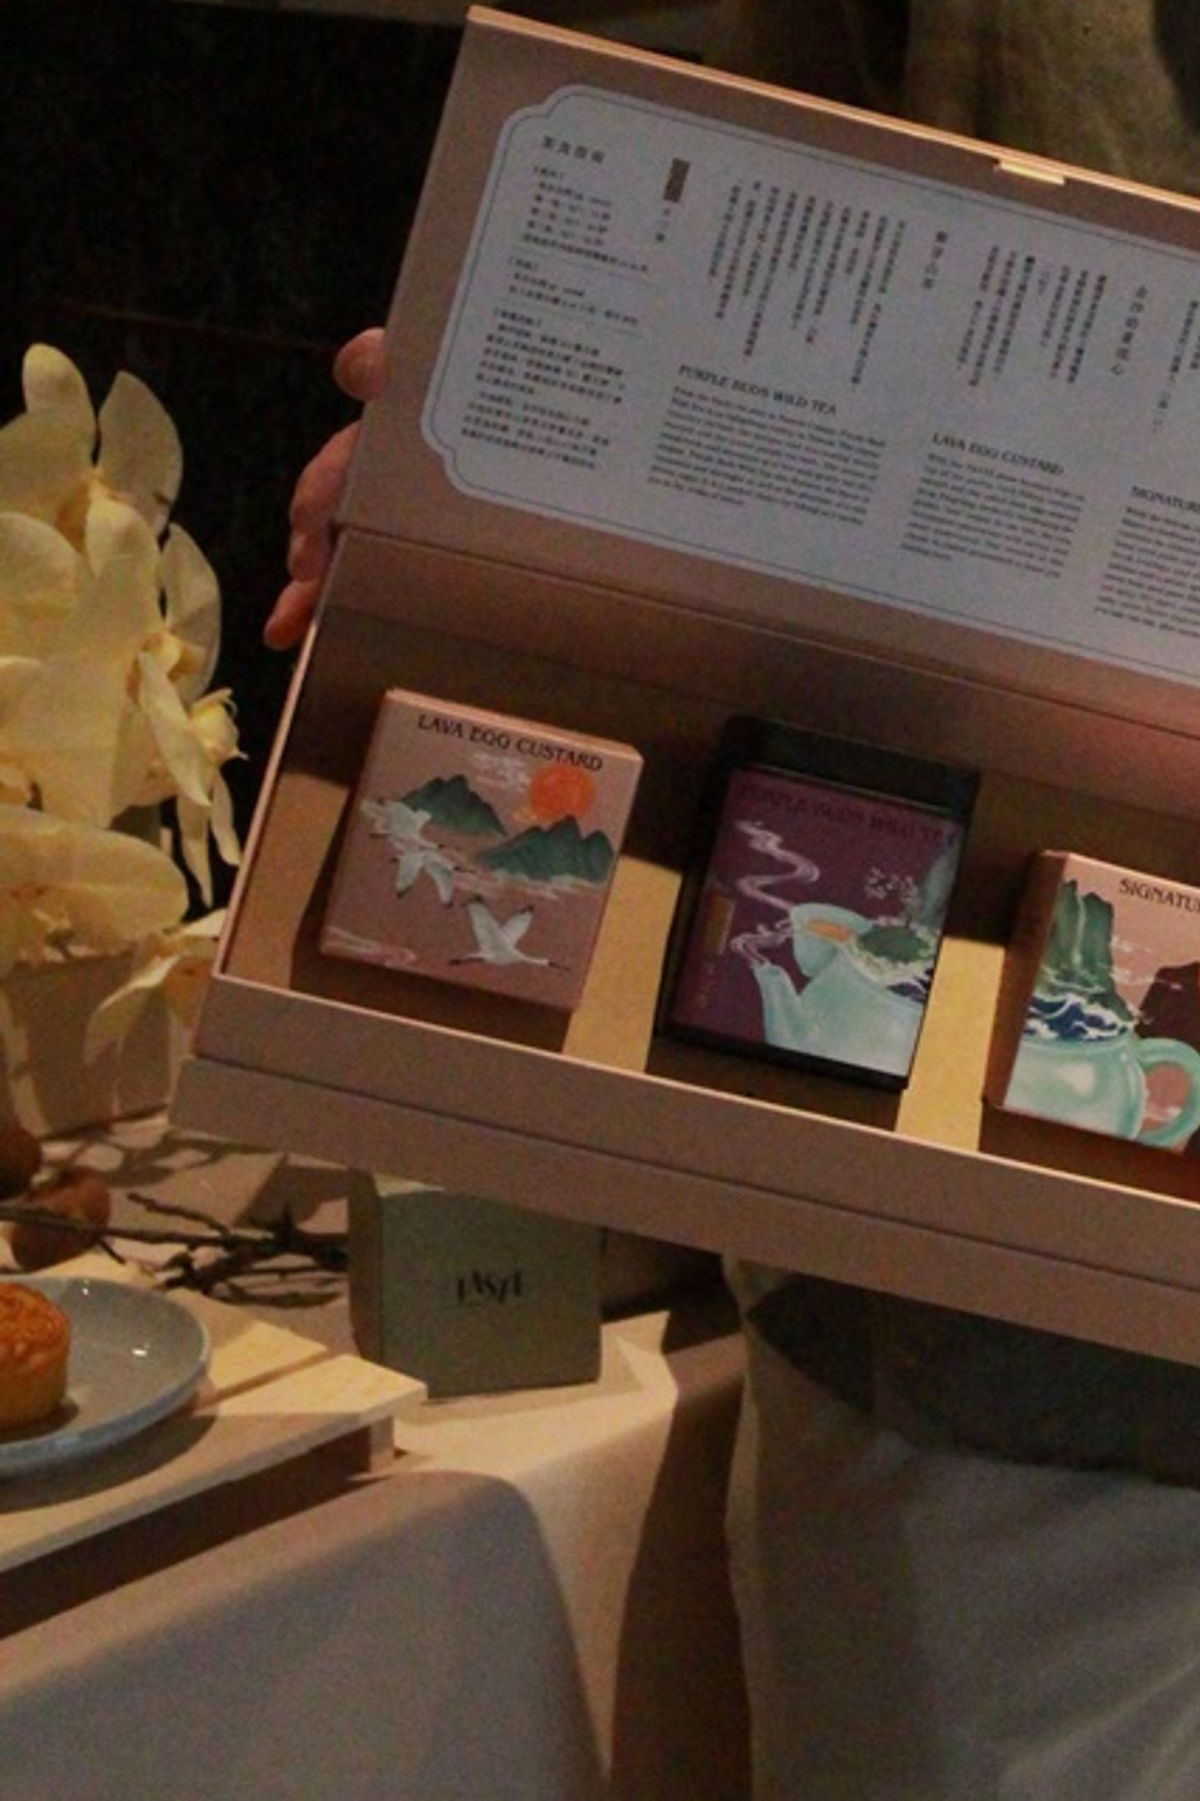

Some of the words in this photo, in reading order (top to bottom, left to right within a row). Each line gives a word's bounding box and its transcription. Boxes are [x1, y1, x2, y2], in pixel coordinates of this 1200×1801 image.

[811, 399, 837, 416] TEA
[931, 431, 966, 452] LAVA
[1001, 450, 1064, 476] CUSTARD
[417, 713, 464, 740] LAVA
[469, 726, 511, 750] EGG
[515, 737, 603, 772] CUSTARD
